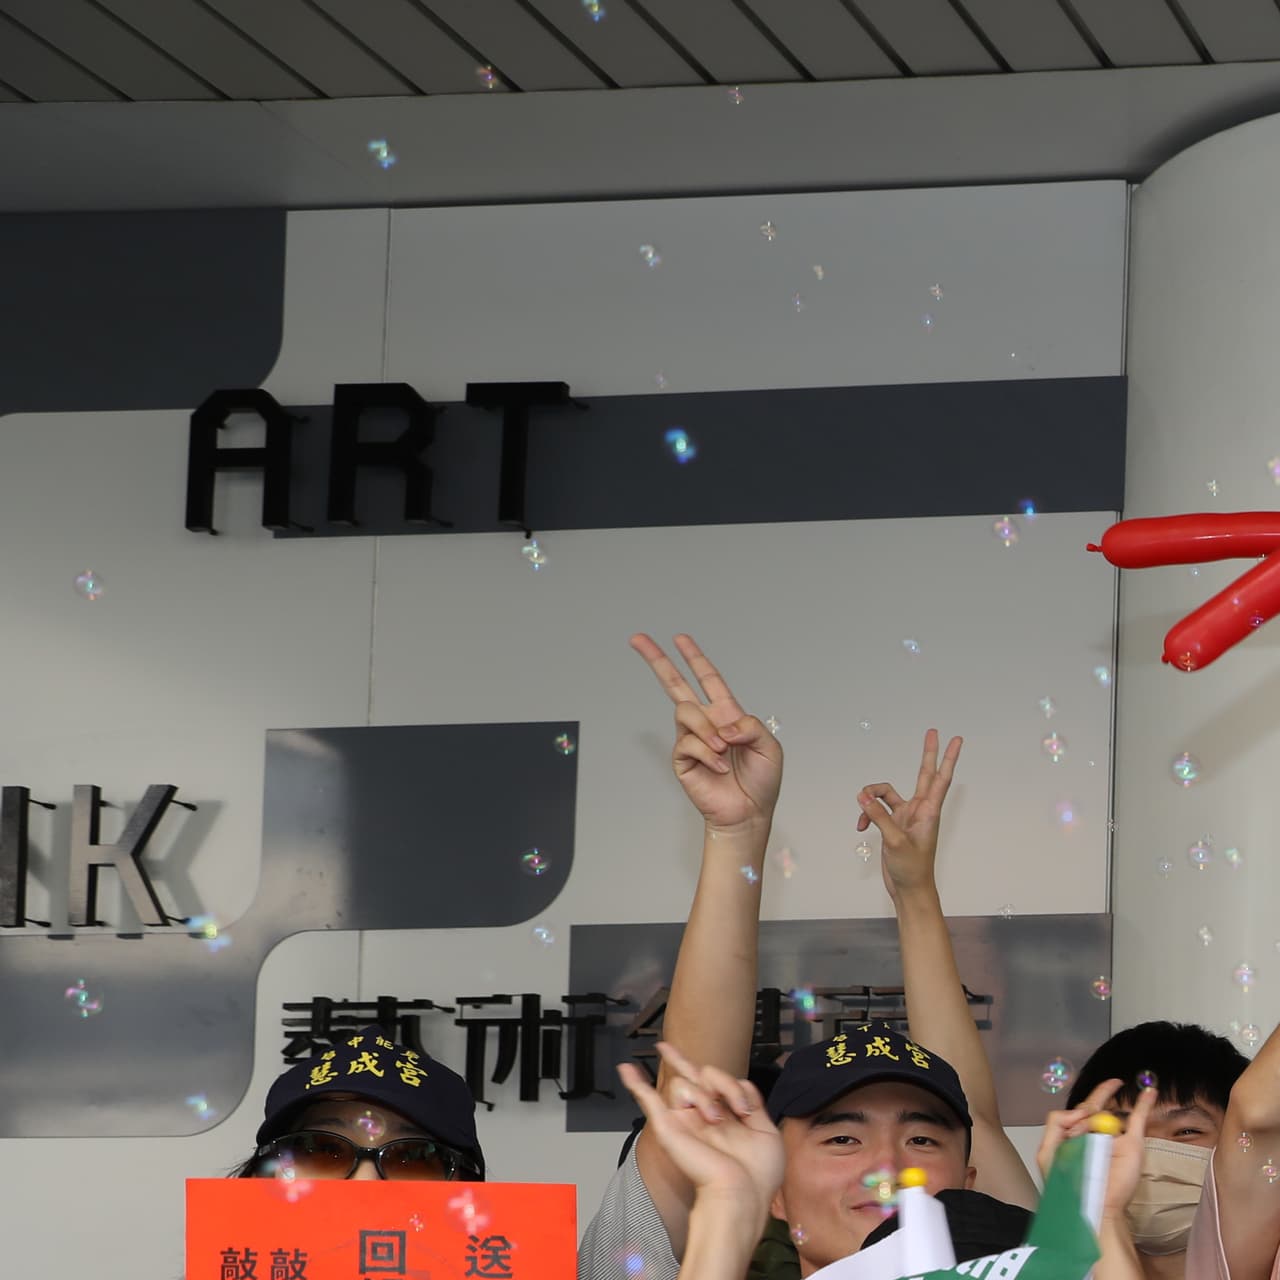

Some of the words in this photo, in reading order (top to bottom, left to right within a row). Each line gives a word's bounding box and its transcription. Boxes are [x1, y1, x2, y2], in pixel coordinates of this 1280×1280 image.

[185, 381, 571, 532] ART
[305, 1051, 428, 1090] 慧成宮
[464, 1235, 515, 1280] 送
